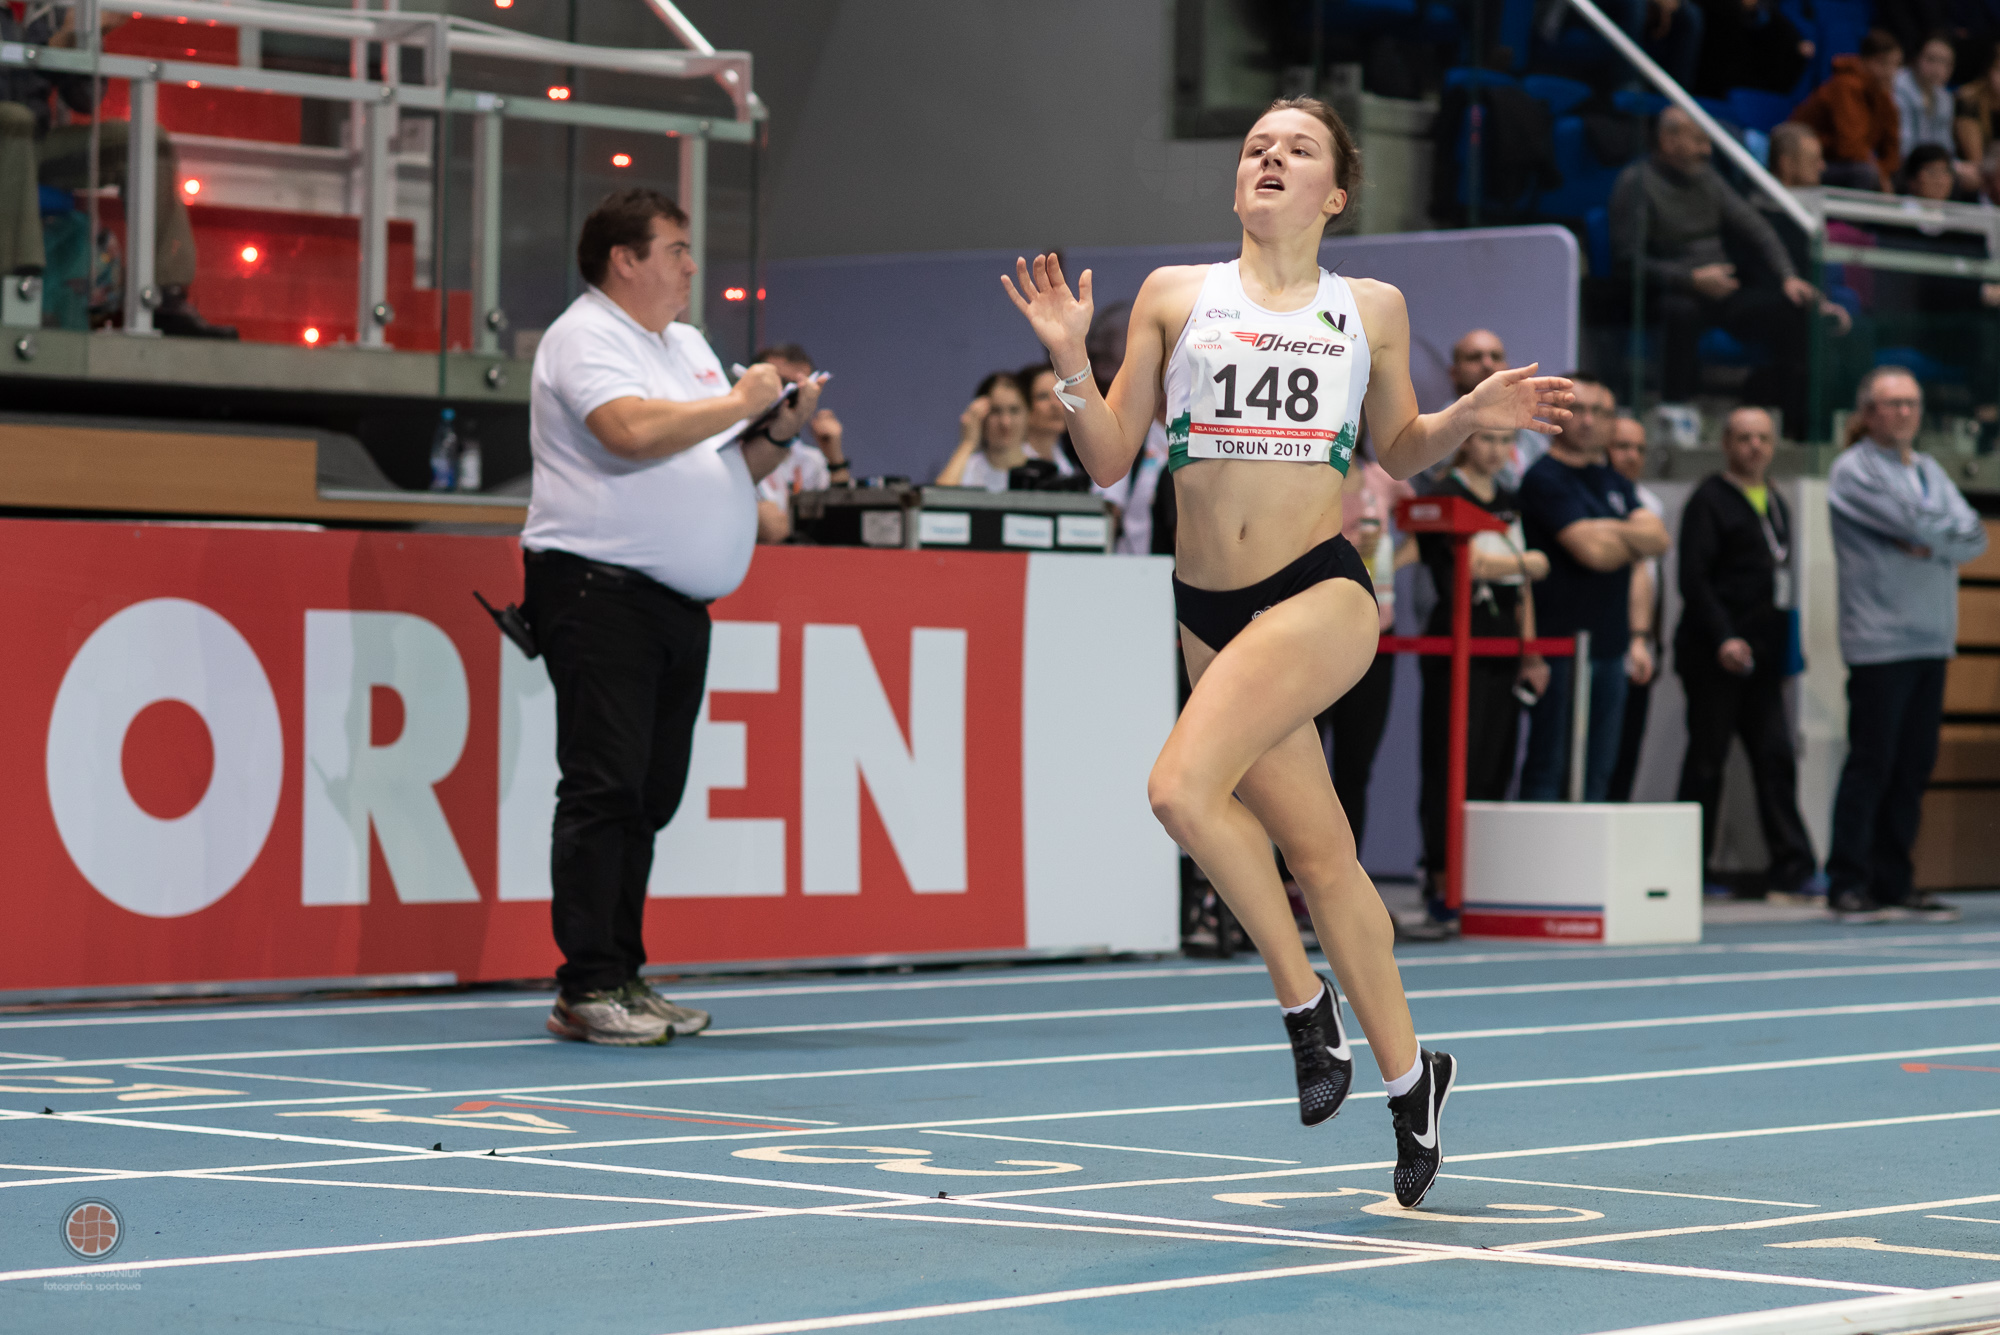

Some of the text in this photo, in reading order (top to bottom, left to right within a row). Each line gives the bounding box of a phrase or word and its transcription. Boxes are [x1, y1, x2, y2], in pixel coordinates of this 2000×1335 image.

[1213, 364, 1319, 422] 148
[1236, 428, 1286, 436] MISTRZOSTWA
[1215, 437, 1312, 457] TORUŃ 2019
